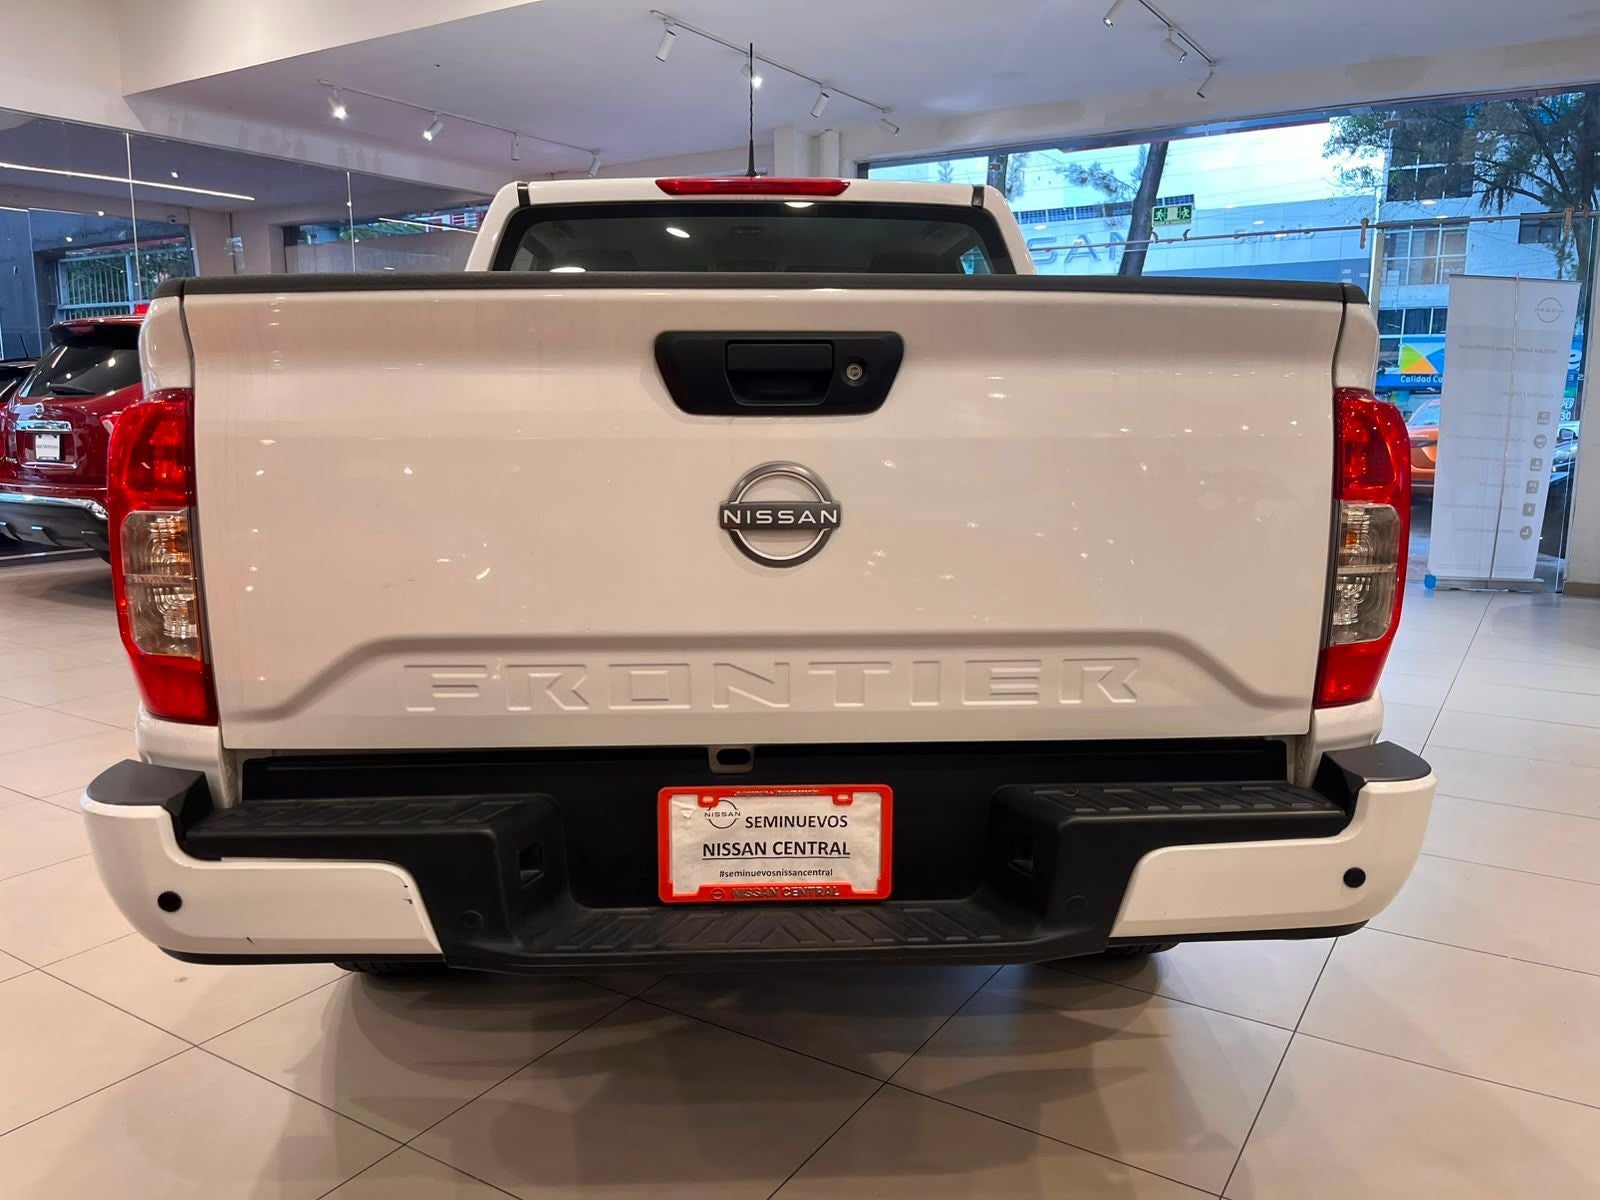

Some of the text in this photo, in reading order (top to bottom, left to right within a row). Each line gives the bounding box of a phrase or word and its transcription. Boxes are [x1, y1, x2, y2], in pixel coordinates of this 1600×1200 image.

[723, 509, 838, 525] NISSAN
[403, 657, 1140, 713] FRONTIER
[704, 808, 741, 818] NISSAN
[744, 815, 849, 829] SEMINUEVOS
[702, 841, 851, 857] NISSAN CENTRAL
[719, 868, 834, 879] #seminuevosnissancentral
[731, 885, 841, 898] NISSAN CENTRAL
